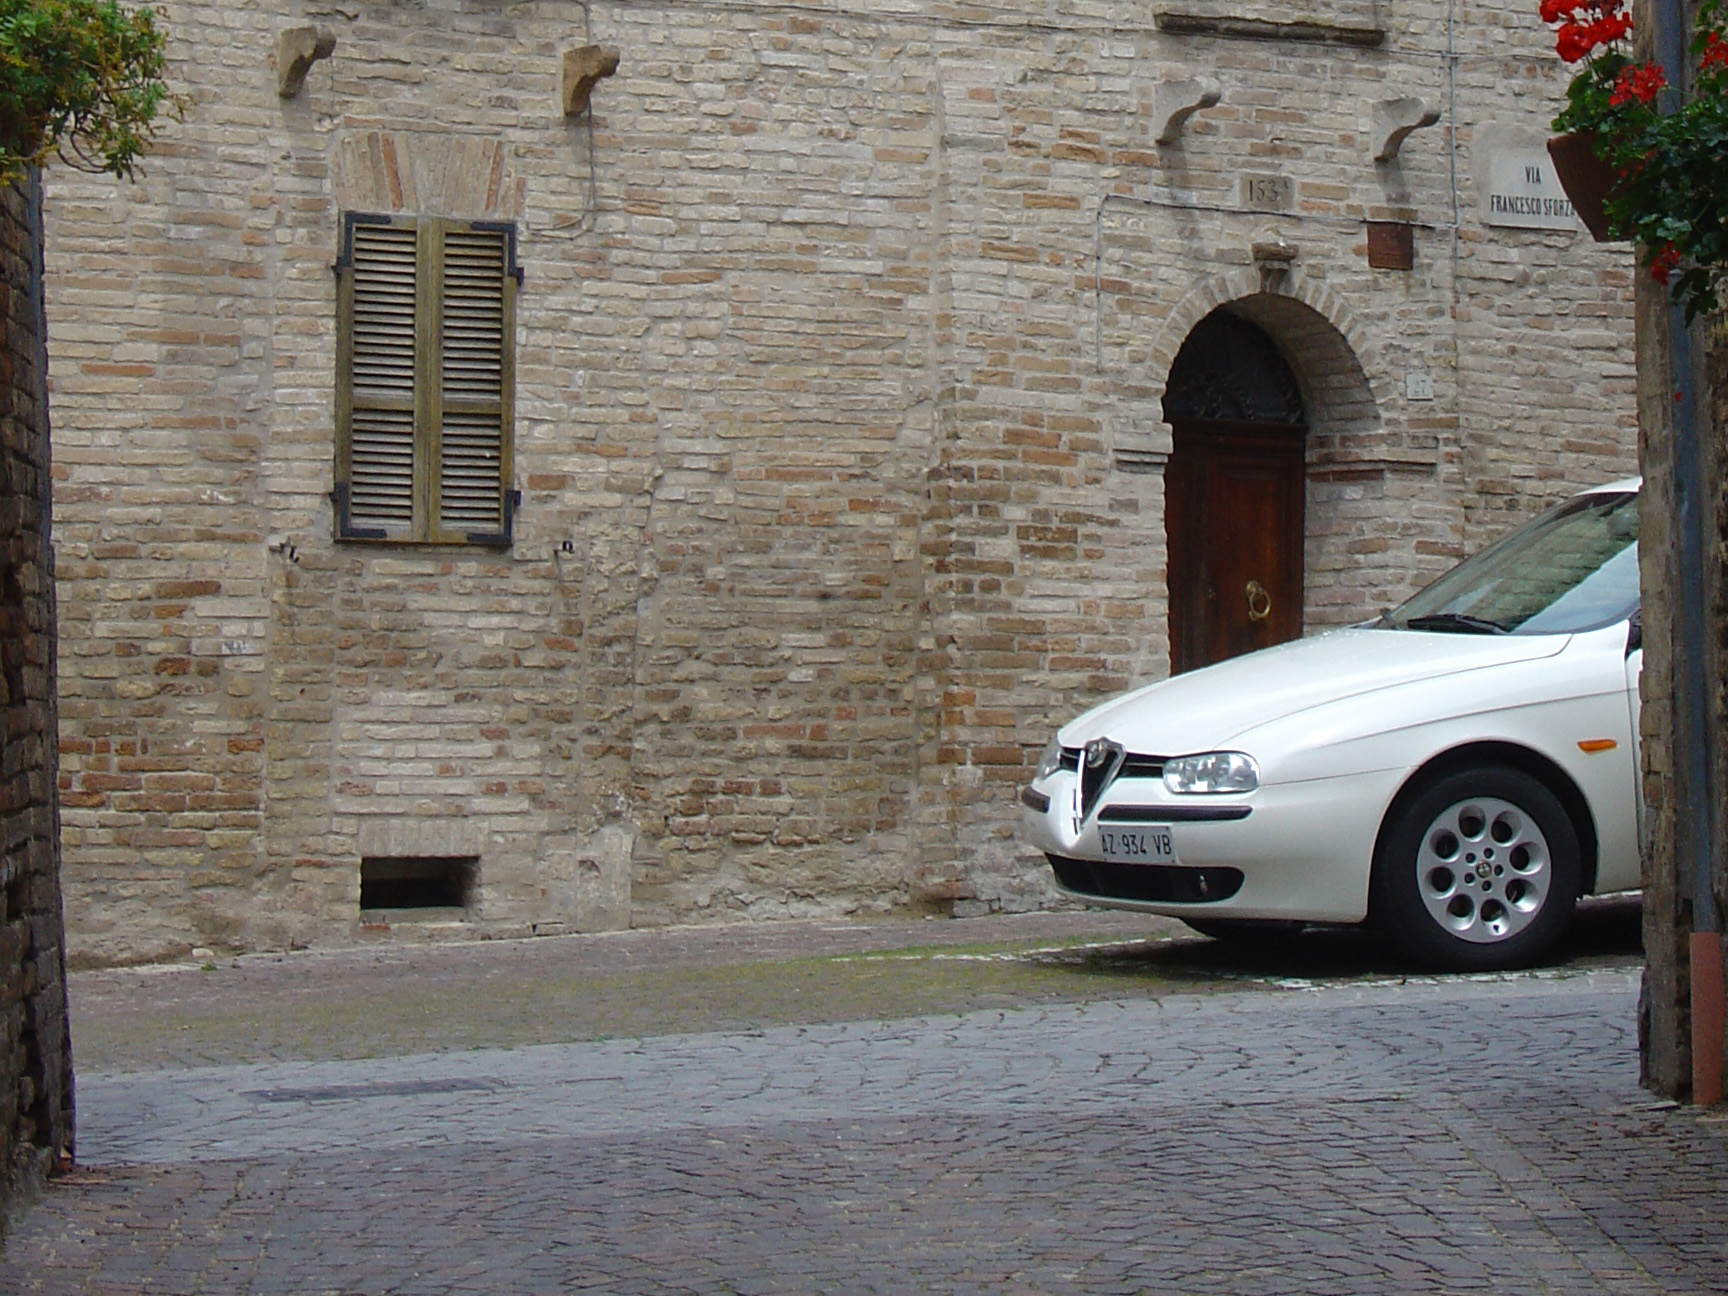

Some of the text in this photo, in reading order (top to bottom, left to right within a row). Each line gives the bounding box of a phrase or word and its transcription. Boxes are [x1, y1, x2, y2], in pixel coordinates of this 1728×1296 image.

[1525, 165, 1542, 184] VIA
[1490, 194, 1541, 215] FRANCESCO
[1101, 833, 1172, 856] AZ 934 VB
